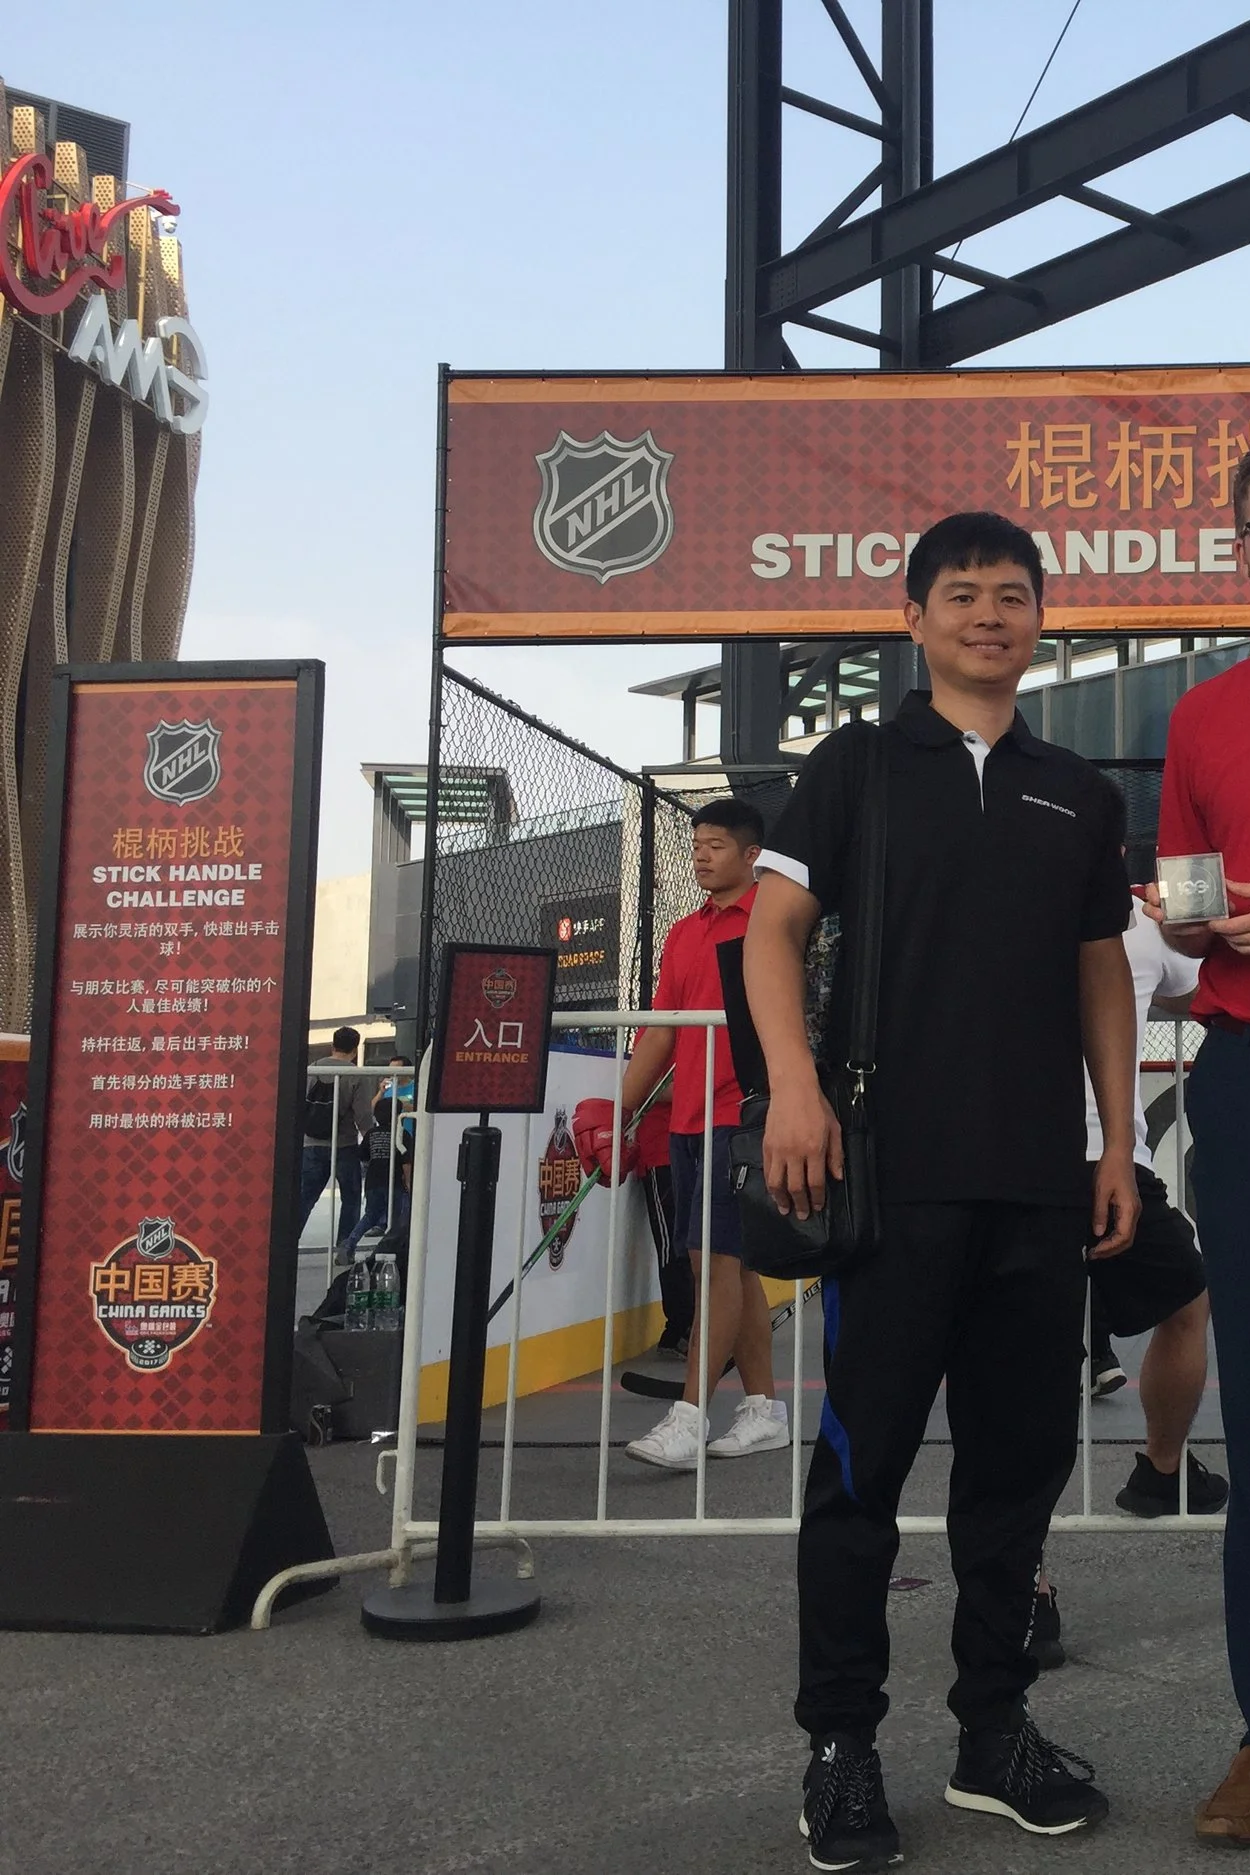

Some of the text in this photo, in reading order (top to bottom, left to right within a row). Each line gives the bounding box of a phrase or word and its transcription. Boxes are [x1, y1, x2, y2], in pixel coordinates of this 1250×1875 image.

[567, 470, 645, 548] NHL
[750, 532, 922, 580] STIC
[161, 741, 206, 787] NHL
[112, 826, 245, 860] 棍柄挑战
[92, 863, 262, 884] STICK HANDLE
[106, 888, 245, 908] CHALLENGE
[159, 940, 181, 956] 球！
[126, 998, 209, 1014] 人最佳战绩！
[464, 1018, 524, 1049] 入口
[455, 1051, 529, 1064] ENTRANCE
[91, 1073, 235, 1090] 首先得分的选手获胜！
[89, 1112, 233, 1129] 用时最快的将被记录！
[145, 1228, 168, 1250] NHL
[95, 1262, 210, 1302] 中国赛
[98, 1304, 206, 1318] CHINA GAMES
